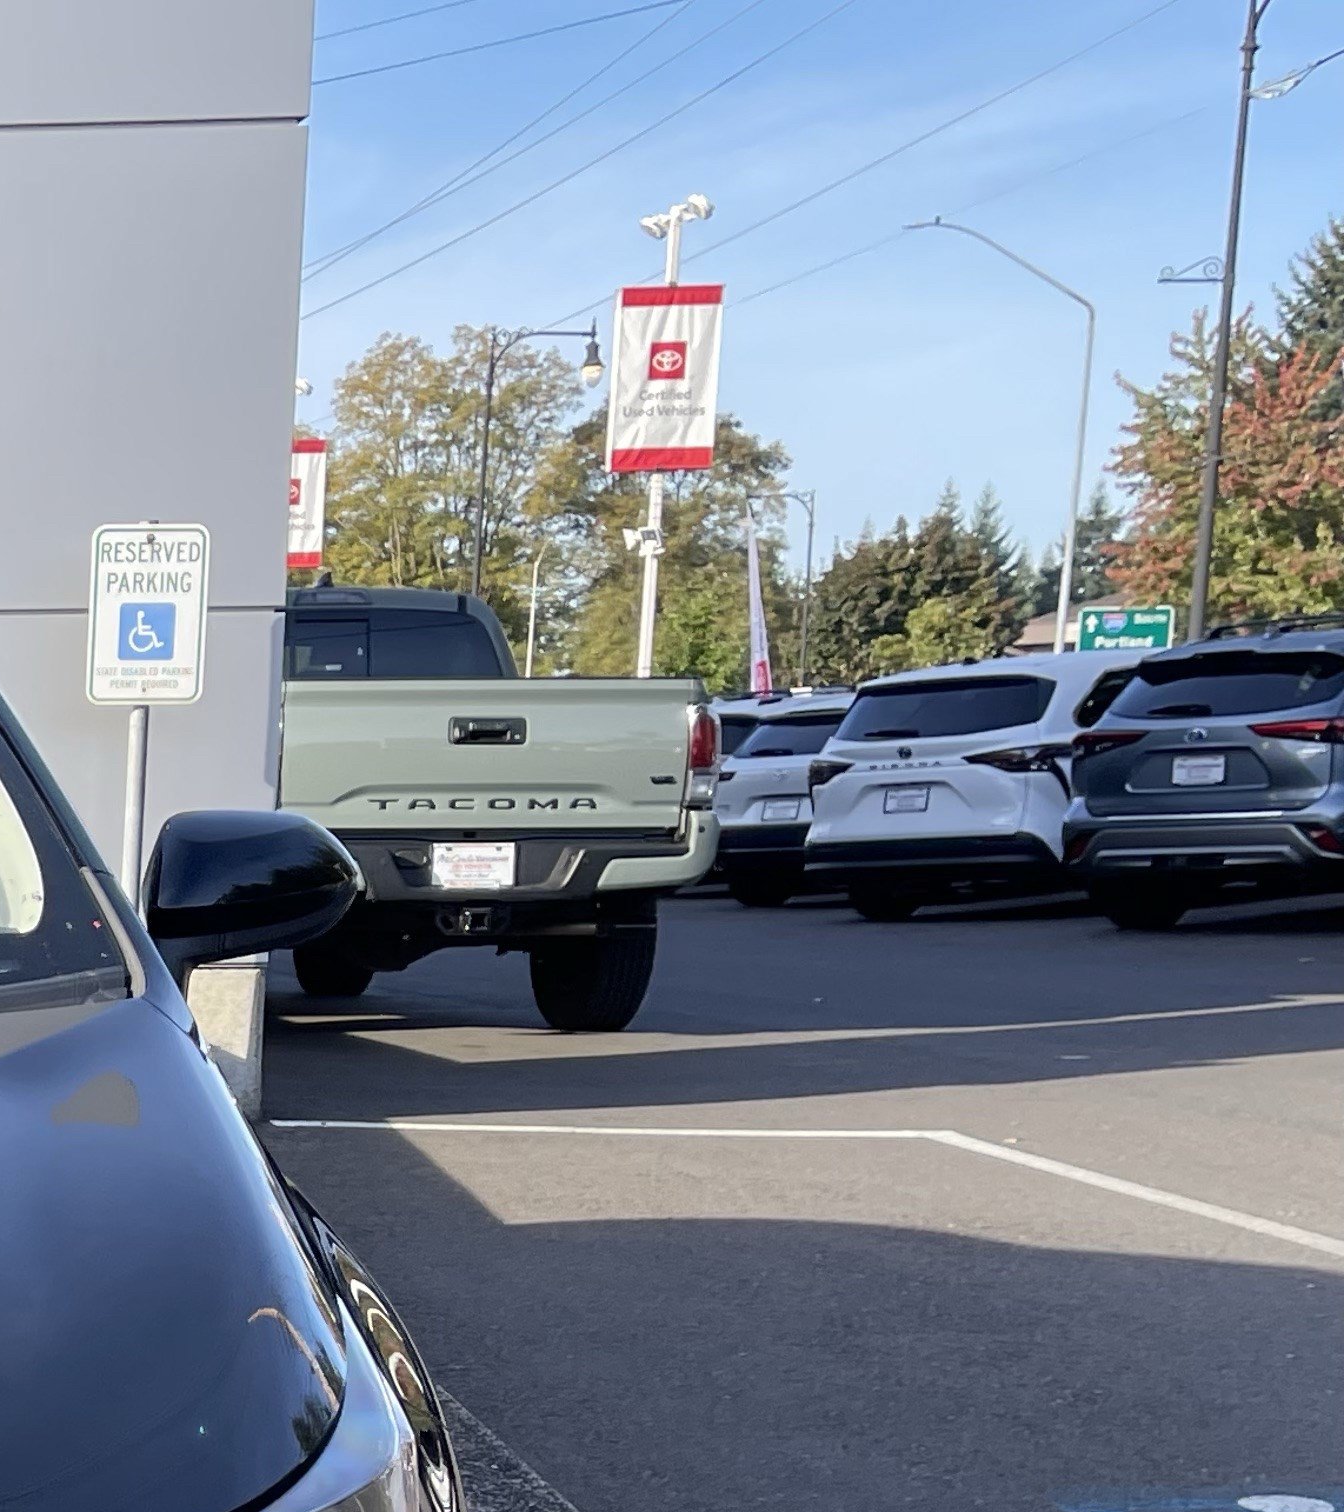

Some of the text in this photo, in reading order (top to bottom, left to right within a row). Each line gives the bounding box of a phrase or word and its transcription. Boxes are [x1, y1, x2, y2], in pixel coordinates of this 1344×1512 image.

[639, 387, 692, 400] Certified
[623, 404, 706, 417] Used Vehicles
[100, 541, 201, 564] RESERVED
[106, 571, 193, 594] PARKING
[110, 679, 179, 689] PERMIT REQUIRED
[367, 797, 598, 811] TACOMA
